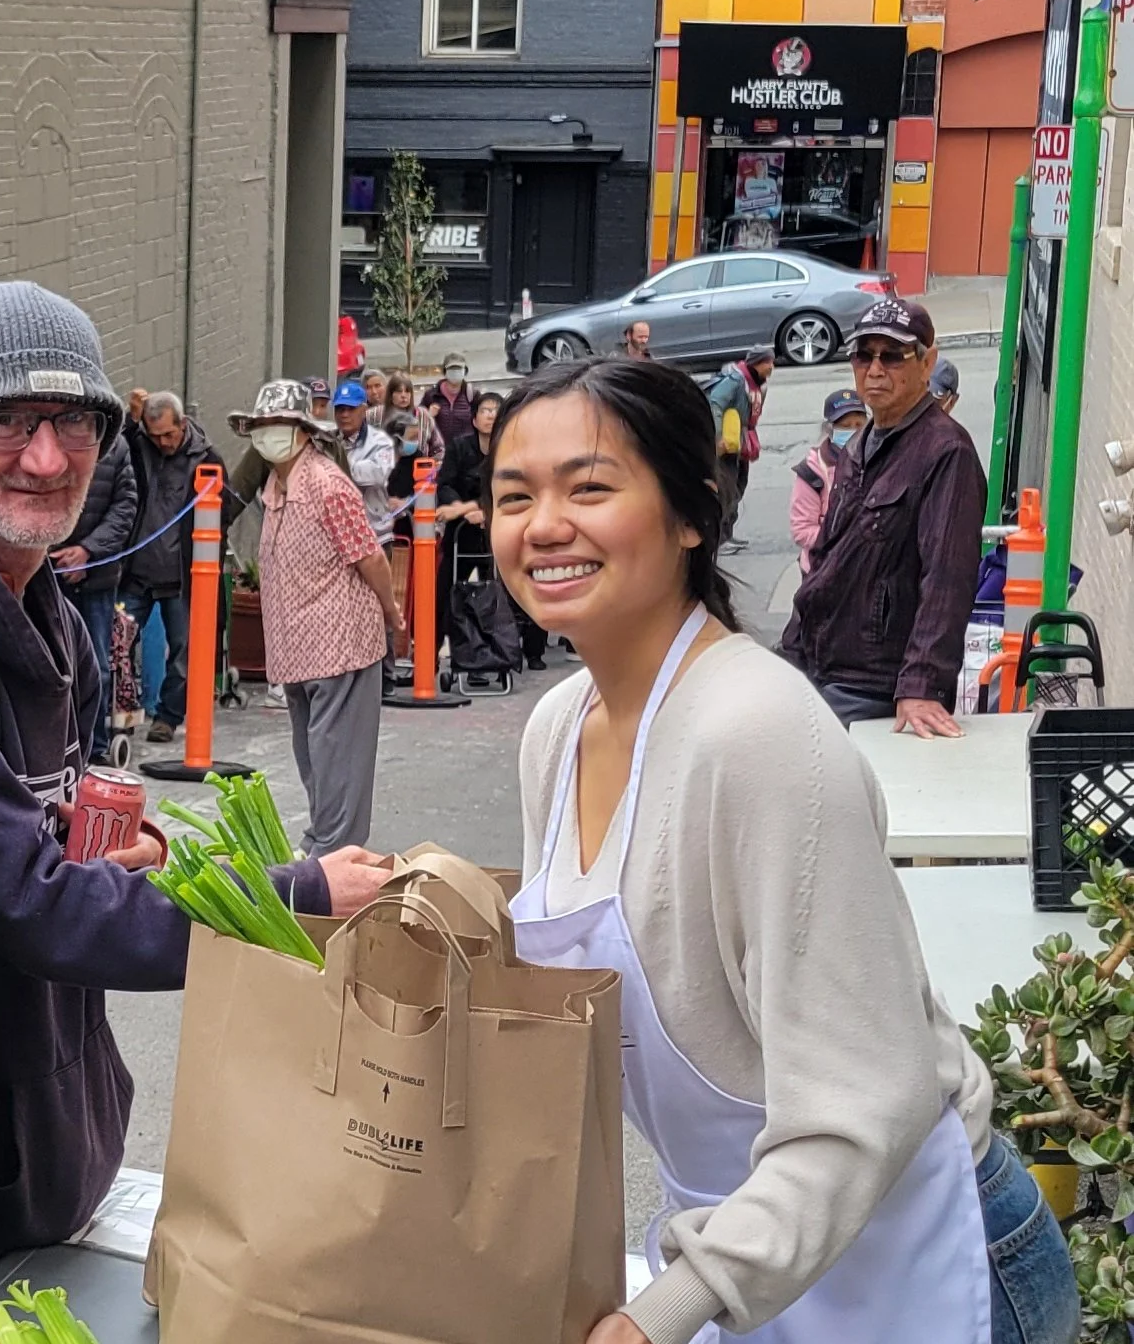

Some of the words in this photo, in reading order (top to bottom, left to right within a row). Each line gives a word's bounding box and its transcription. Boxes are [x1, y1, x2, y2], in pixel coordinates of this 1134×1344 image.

[748, 79, 783, 90] LARRY
[786, 79, 829, 91] FLYNT'S
[731, 86, 795, 104] HUSTLER
[1039, 129, 1066, 157] NO
[390, 1135, 424, 1152] LIFE
